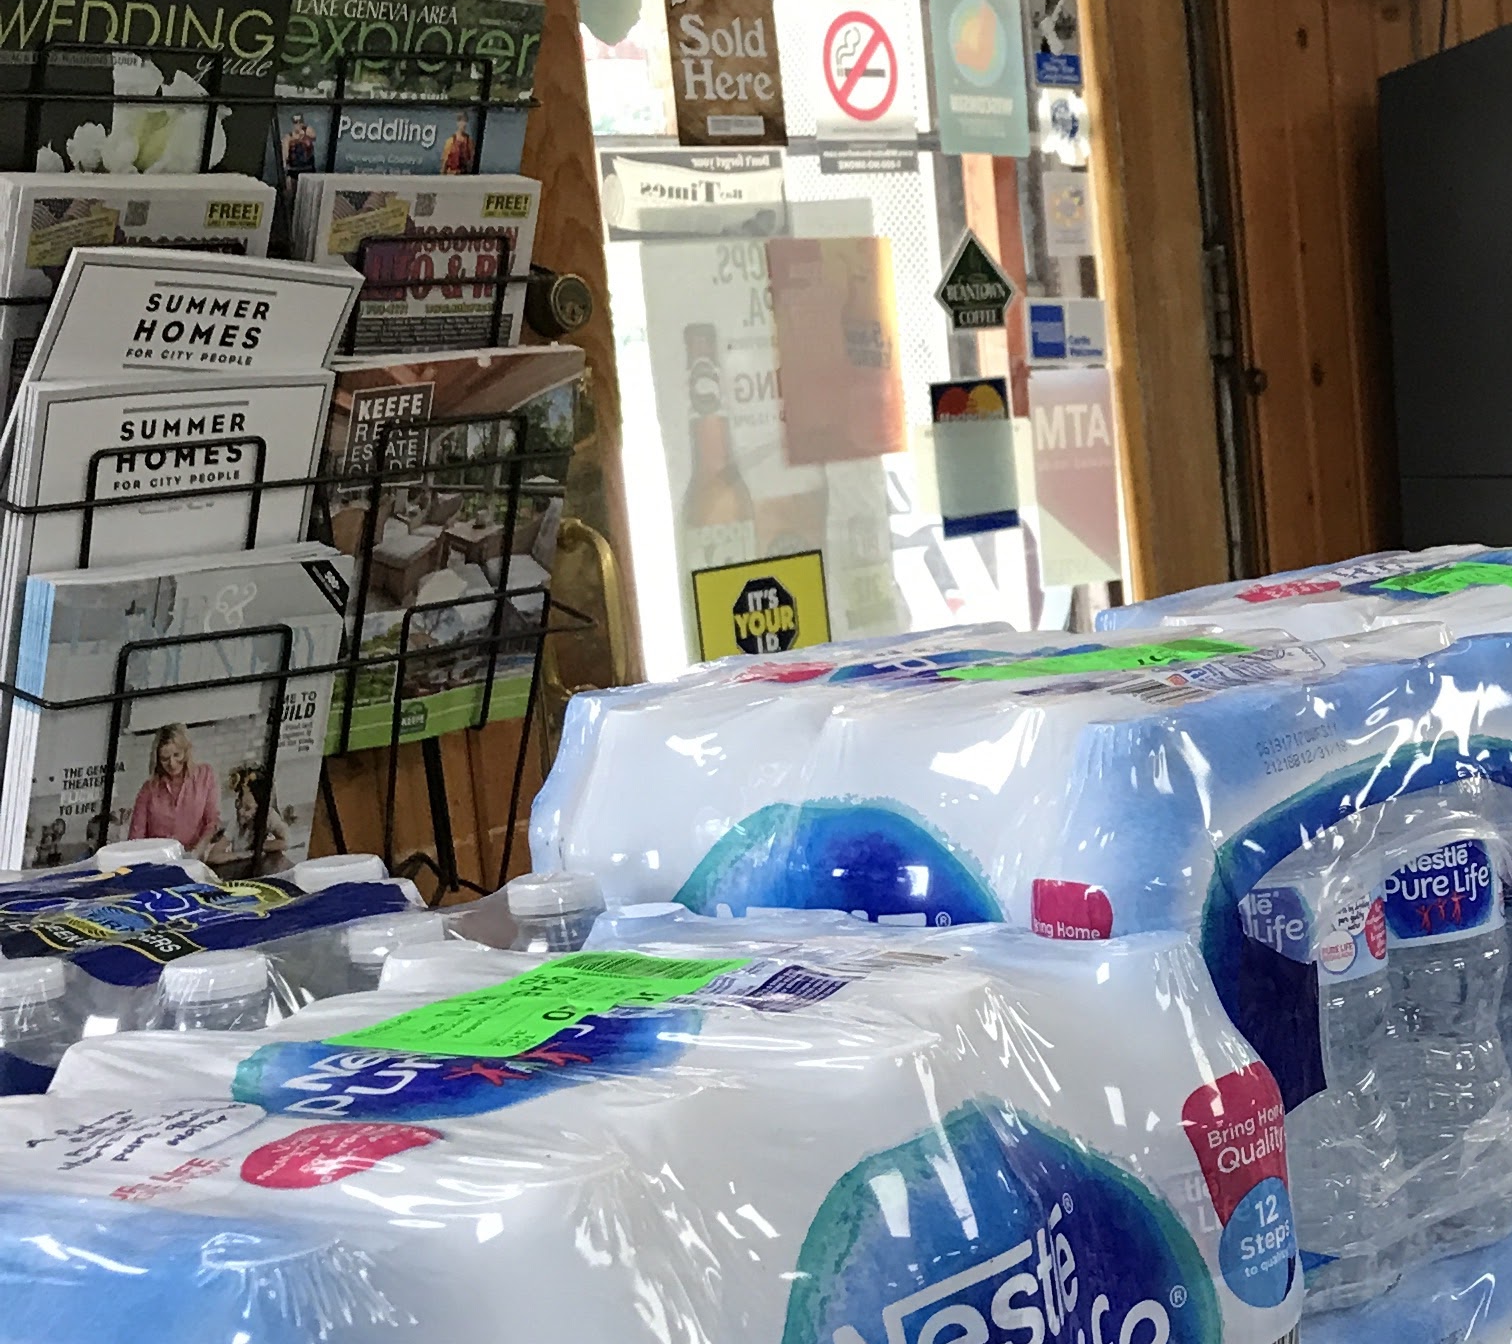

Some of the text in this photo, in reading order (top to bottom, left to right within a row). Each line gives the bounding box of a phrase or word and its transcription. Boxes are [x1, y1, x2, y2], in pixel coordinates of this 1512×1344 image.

[415, 4, 458, 26] AREA
[282, 12, 541, 80] explorer
[679, 13, 767, 59] Sold
[682, 56, 776, 103] Here
[337, 114, 438, 149] Paddling
[206, 200, 260, 221] FREE!
[485, 193, 531, 214] FREE!
[145, 292, 271, 322] SUMMER
[958, 309, 1000, 326] COFFEE
[132, 319, 262, 350] HOMES
[125, 347, 254, 367] FOR CITY PEOPLE
[358, 393, 424, 423] KEEFE
[119, 411, 248, 442] SUMMER
[115, 443, 244, 475] HOMES
[351, 438, 419, 463] ESATE
[113, 468, 241, 492] FOR CITY PEOPLE
[748, 587, 779, 613] IT'S
[733, 605, 797, 641] YOUR
[300, 691, 318, 704] TO
[64, 766, 85, 780] THE
[59, 802, 98, 817] TO LIFE
[1383, 864, 1490, 901] Pure Life
[1254, 915, 1306, 948] Life
[1206, 1117, 1255, 1149] Bring
[1217, 1125, 1287, 1174] Quality
[1254, 1193, 1281, 1228] 12
[1239, 1218, 1291, 1261] Steps
[1244, 1264, 1259, 1278] to
